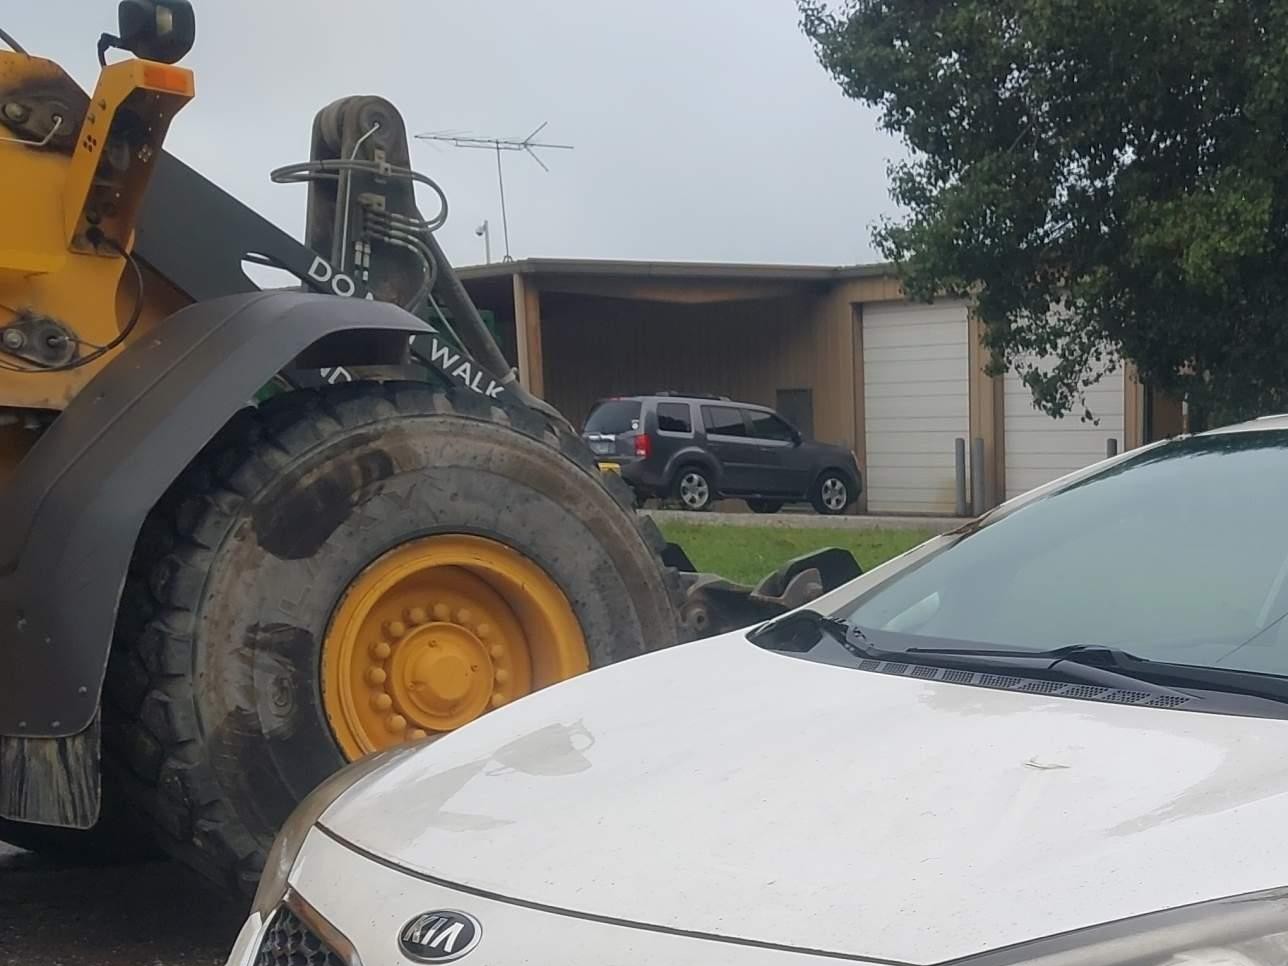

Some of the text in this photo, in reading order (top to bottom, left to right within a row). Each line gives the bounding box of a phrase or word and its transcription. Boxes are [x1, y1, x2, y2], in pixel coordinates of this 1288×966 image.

[307, 255, 505, 399] DO WALK
[403, 914, 464, 953] KIA
